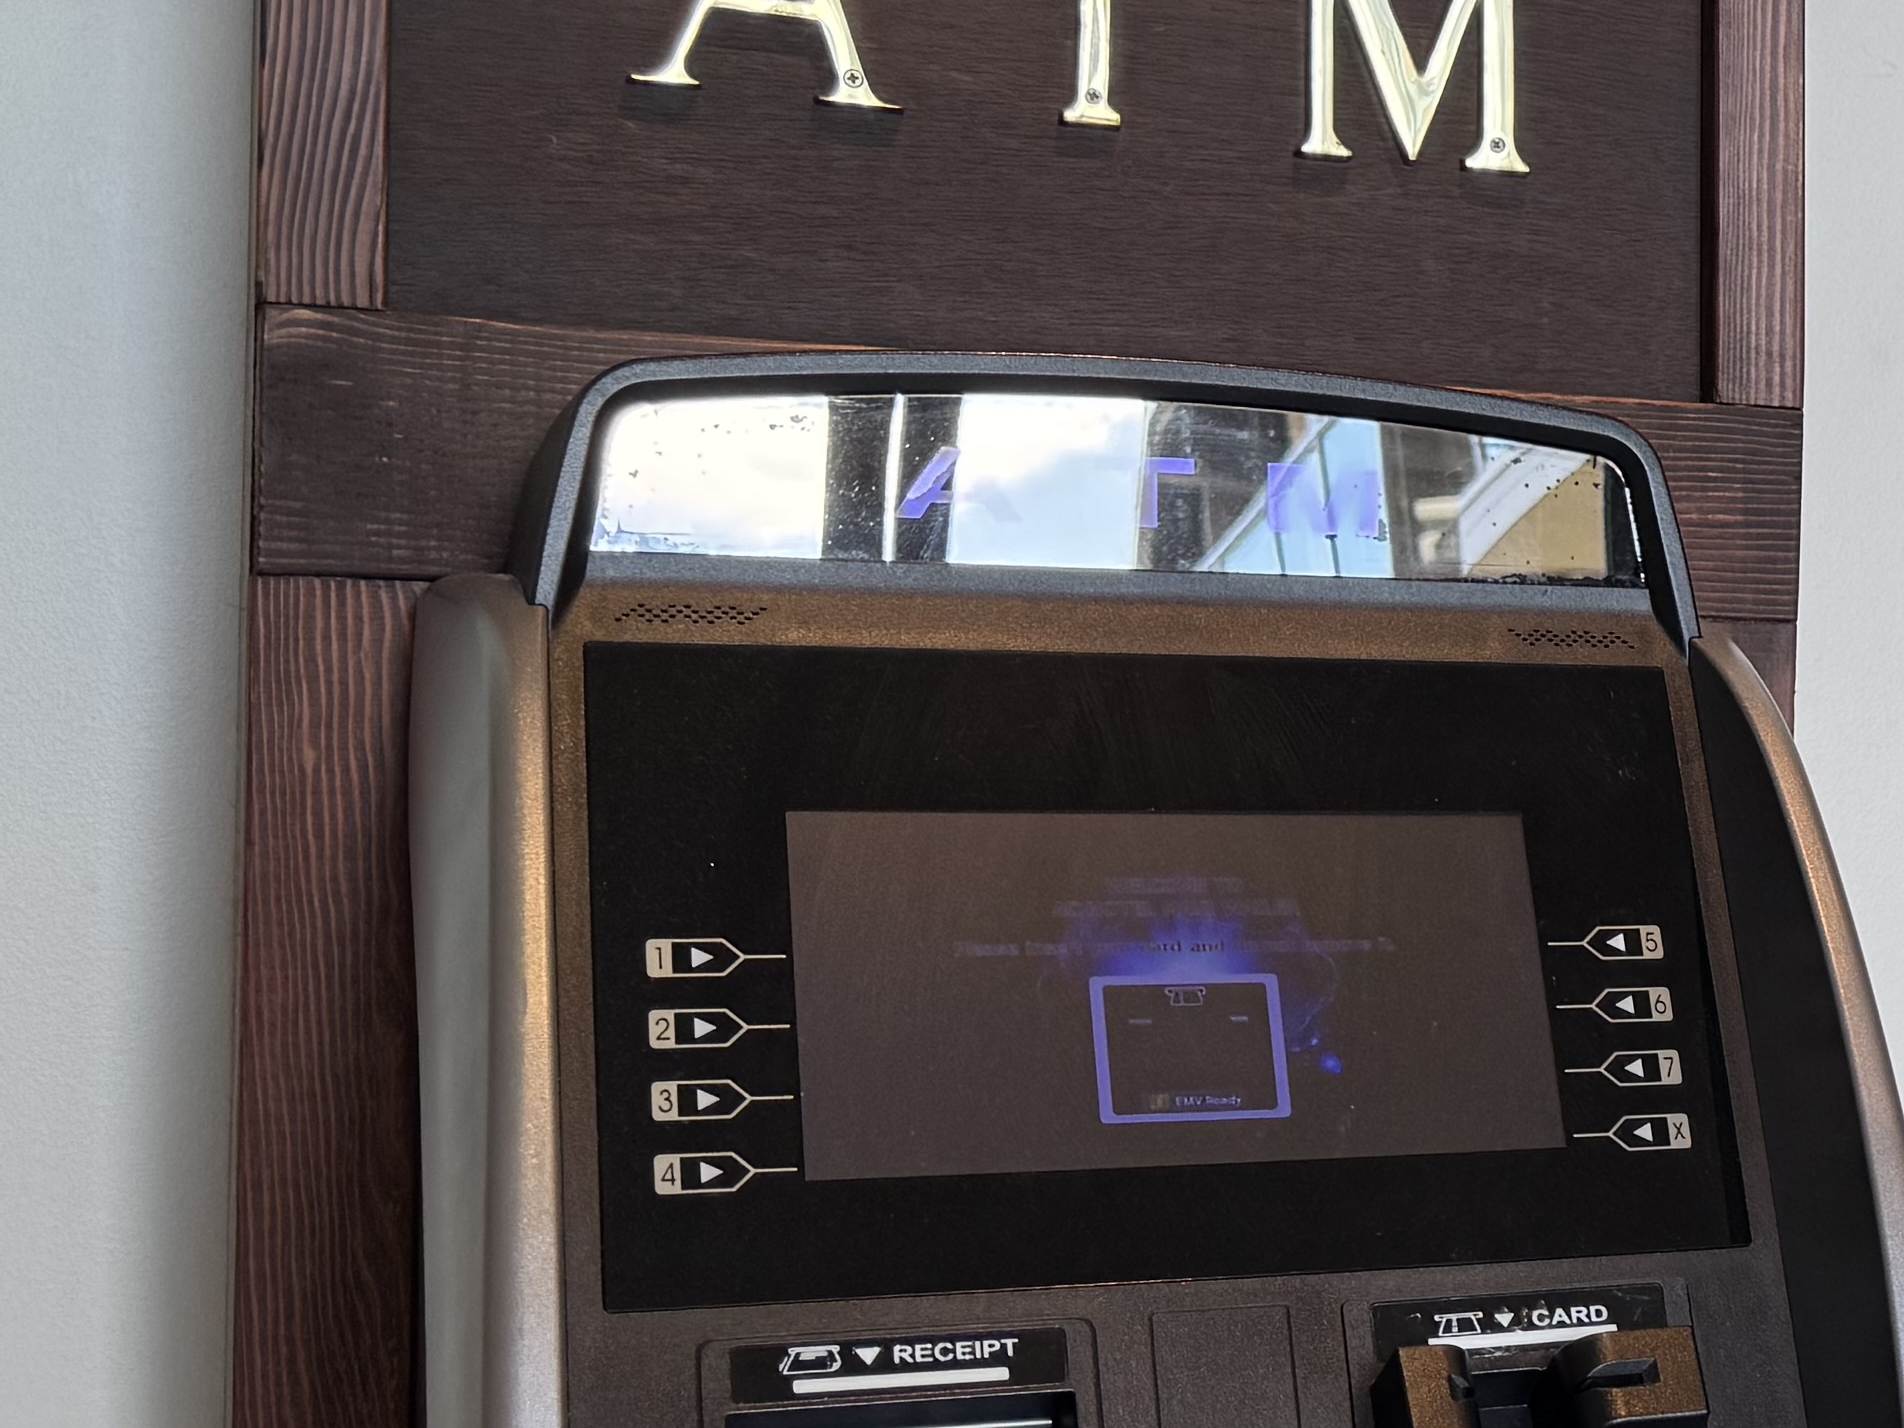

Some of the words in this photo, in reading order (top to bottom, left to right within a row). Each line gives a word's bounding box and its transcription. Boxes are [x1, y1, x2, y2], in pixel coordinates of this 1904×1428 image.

[1645, 931, 1658, 952] 5
[653, 947, 664, 970] 1
[1654, 993, 1667, 1015] 6
[654, 1017, 671, 1041] 2
[1662, 1056, 1675, 1078] 7
[657, 1088, 674, 1114] 3
[1671, 1121, 1686, 1140] X
[660, 1162, 677, 1187] 4
[1531, 1304, 1609, 1328] CARD
[892, 1338, 1019, 1364] RECEIPT
